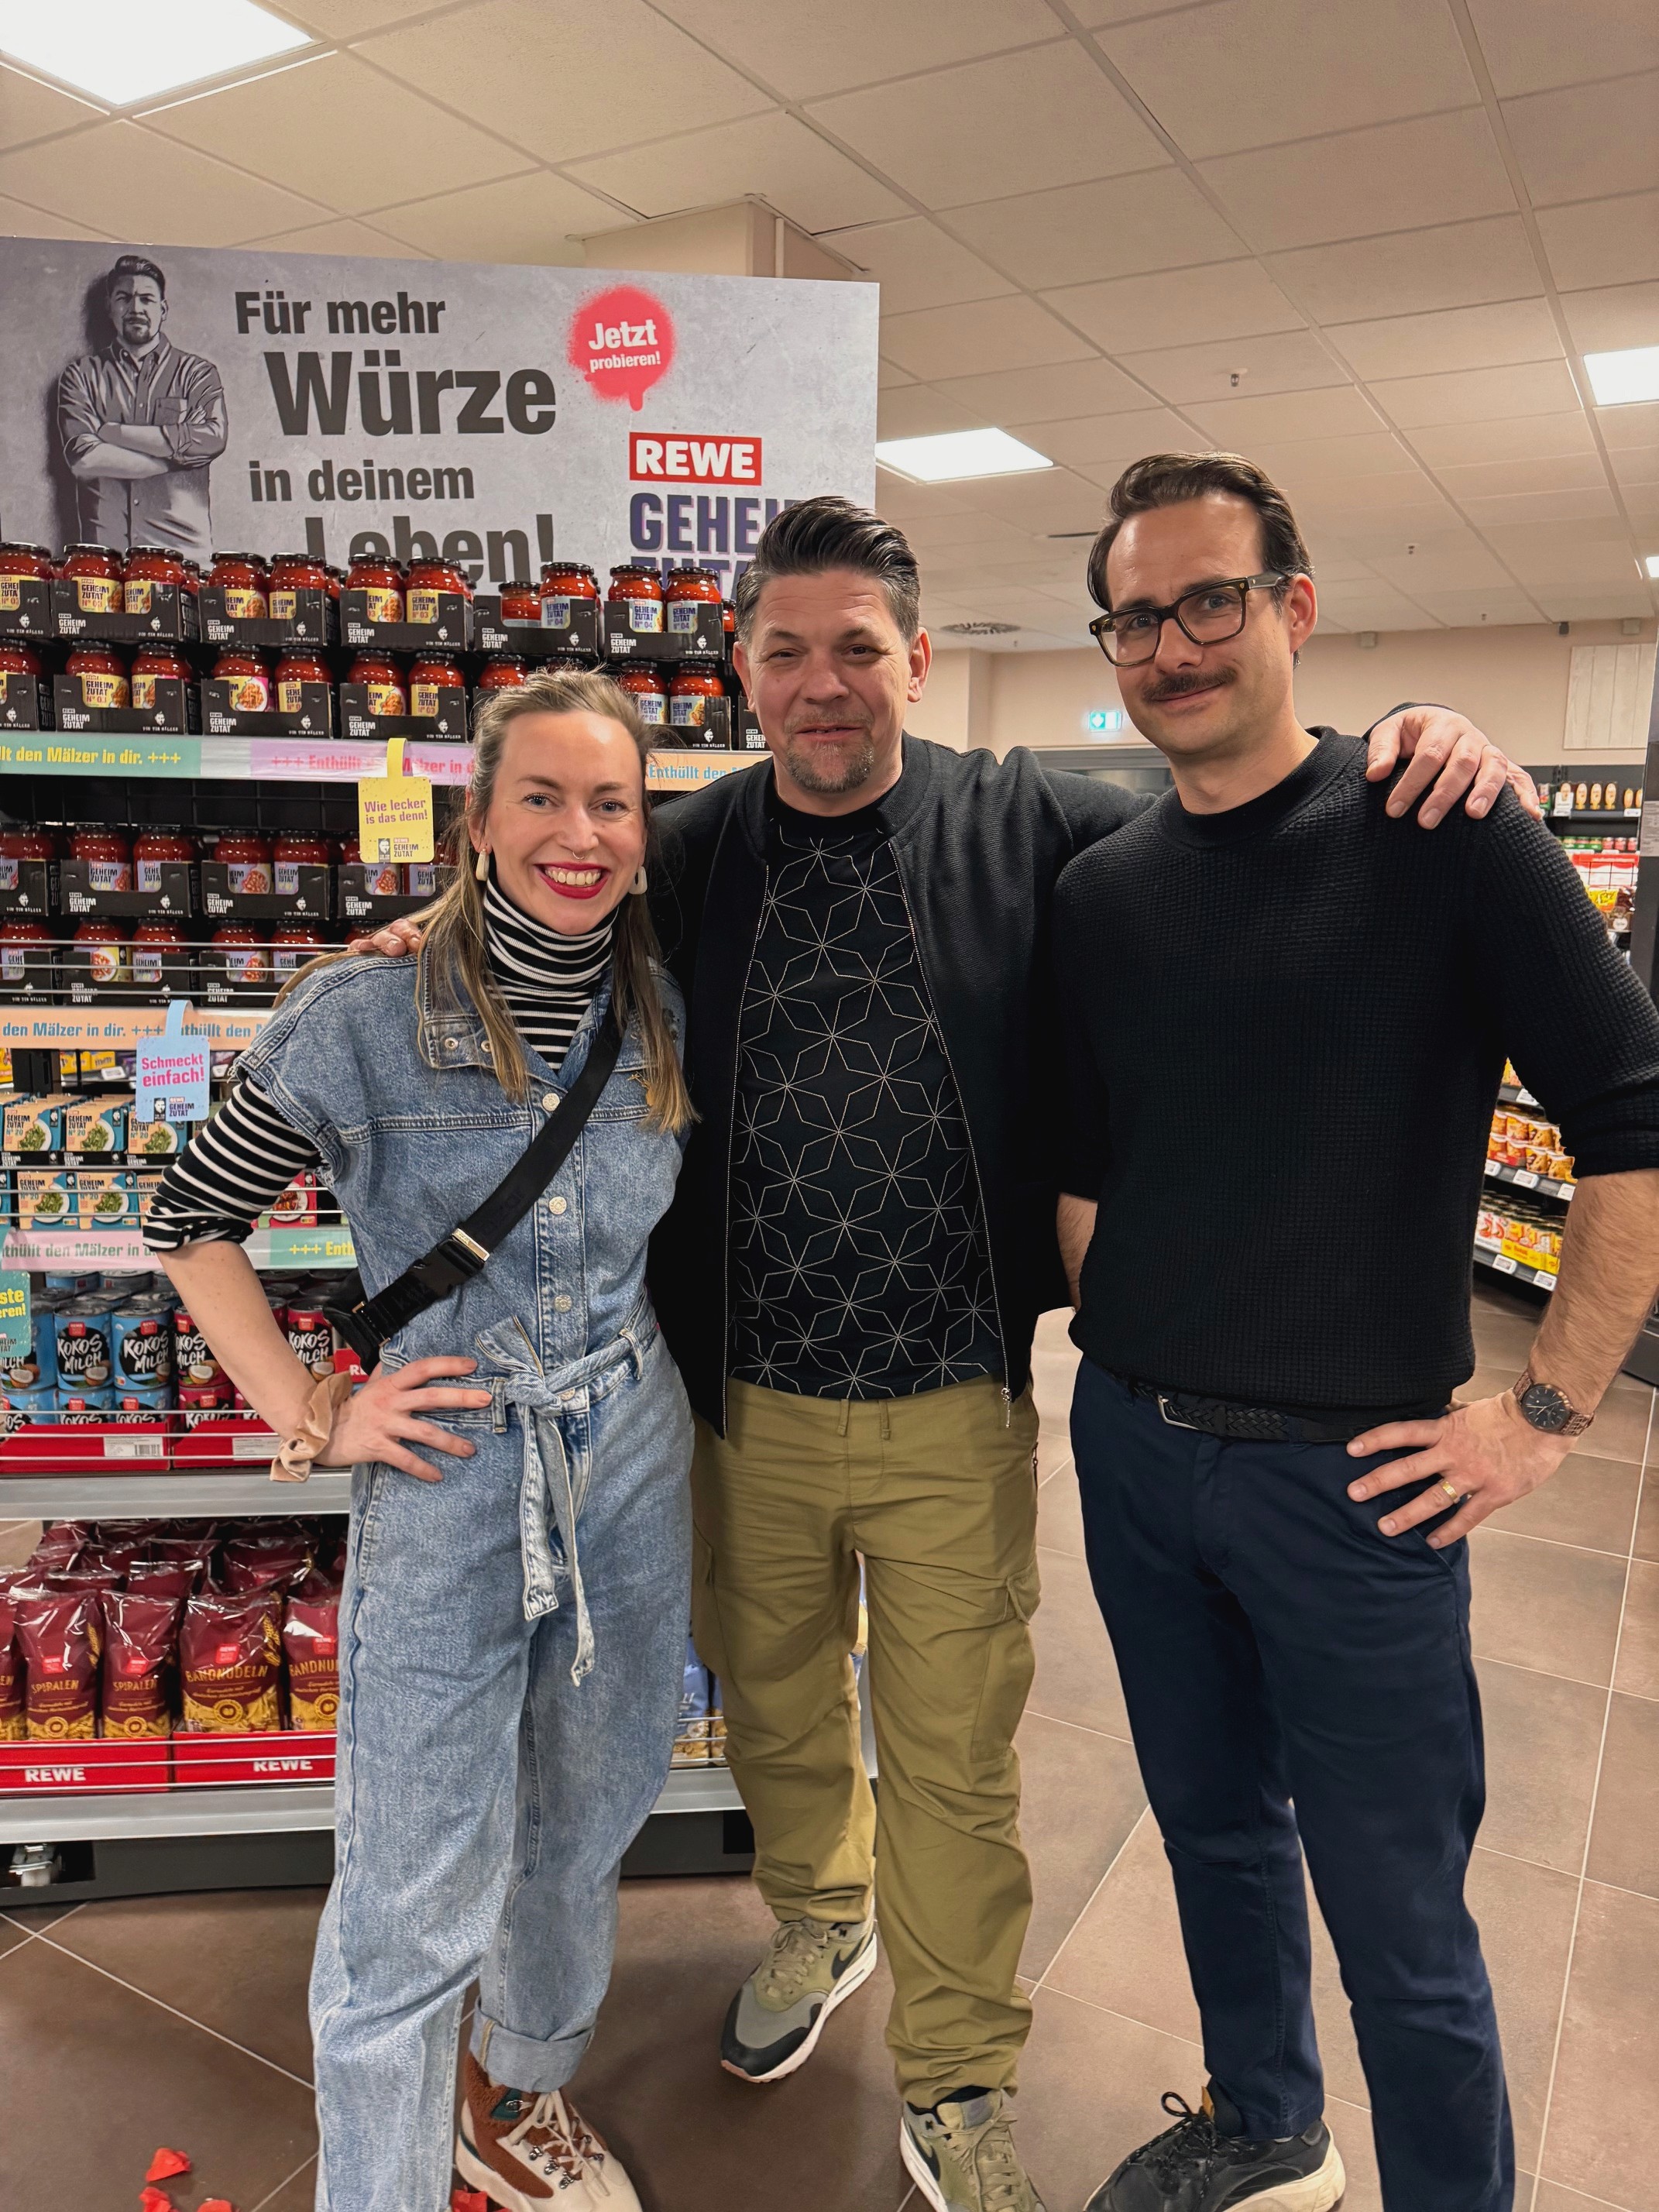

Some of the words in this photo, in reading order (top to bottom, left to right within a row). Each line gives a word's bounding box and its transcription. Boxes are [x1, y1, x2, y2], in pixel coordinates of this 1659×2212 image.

[235, 291, 311, 335] Für
[328, 292, 445, 335] mehr
[588, 318, 658, 350] Jetzt
[589, 351, 661, 373] probieren!
[264, 349, 556, 435] Würze
[635, 439, 756, 479] REWE
[249, 461, 291, 502] in
[308, 460, 474, 502] deinem
[16, 747, 42, 761] den
[47, 747, 98, 763] Mälzer
[102, 749, 115, 764] in
[120, 750, 143, 764] dir.
[450, 760, 462, 774] in
[648, 764, 699, 779] Enthüllt
[364, 801, 387, 812] Wie
[390, 799, 426, 810] lecker
[366, 815, 375, 824] is
[379, 813, 396, 823] das
[400, 809, 428, 822] denn!
[3, 1022, 28, 1036] den
[33, 1022, 83, 1036] Mälzer
[87, 1023, 99, 1036] in
[104, 1023, 125, 1036] dir.
[181, 1023, 221, 1037] thüllt
[226, 1024, 251, 1037] den
[142, 1053, 204, 1070] Schmeckt
[143, 1067, 204, 1087] einfach!
[2, 1244, 41, 1258] thüllt
[46, 1244, 70, 1257] den
[75, 1243, 123, 1257] Mälzer
[128, 1244, 139, 1256] in
[57, 1334, 102, 1360] KOKOS
[123, 1331, 169, 1360] KOKOS
[64, 1351, 102, 1374] MILCH
[134, 1348, 169, 1374] MILCH
[185, 1665, 268, 1682] BANDNUDELN
[290, 1659, 338, 1677] BANDNU
[31, 1680, 79, 1694] SPIRALEN
[253, 1760, 313, 1772] REWE
[26, 1768, 86, 1782] REWE
